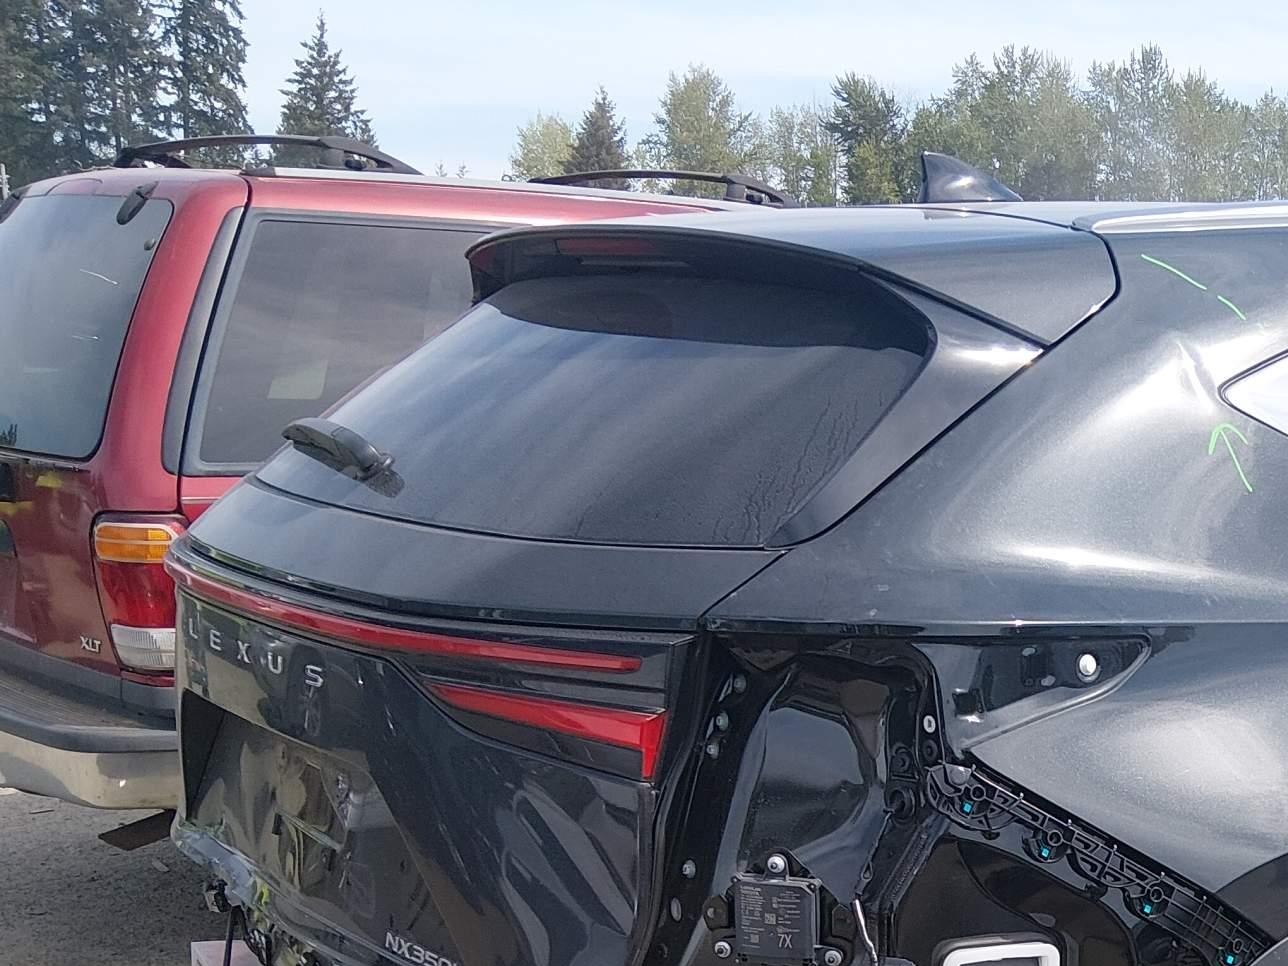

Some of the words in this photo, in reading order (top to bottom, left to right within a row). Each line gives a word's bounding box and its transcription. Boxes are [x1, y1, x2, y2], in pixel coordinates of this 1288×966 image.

[80, 635, 102, 653] XLT
[188, 618, 324, 688] LEXUS
[777, 933, 793, 949] 7X
